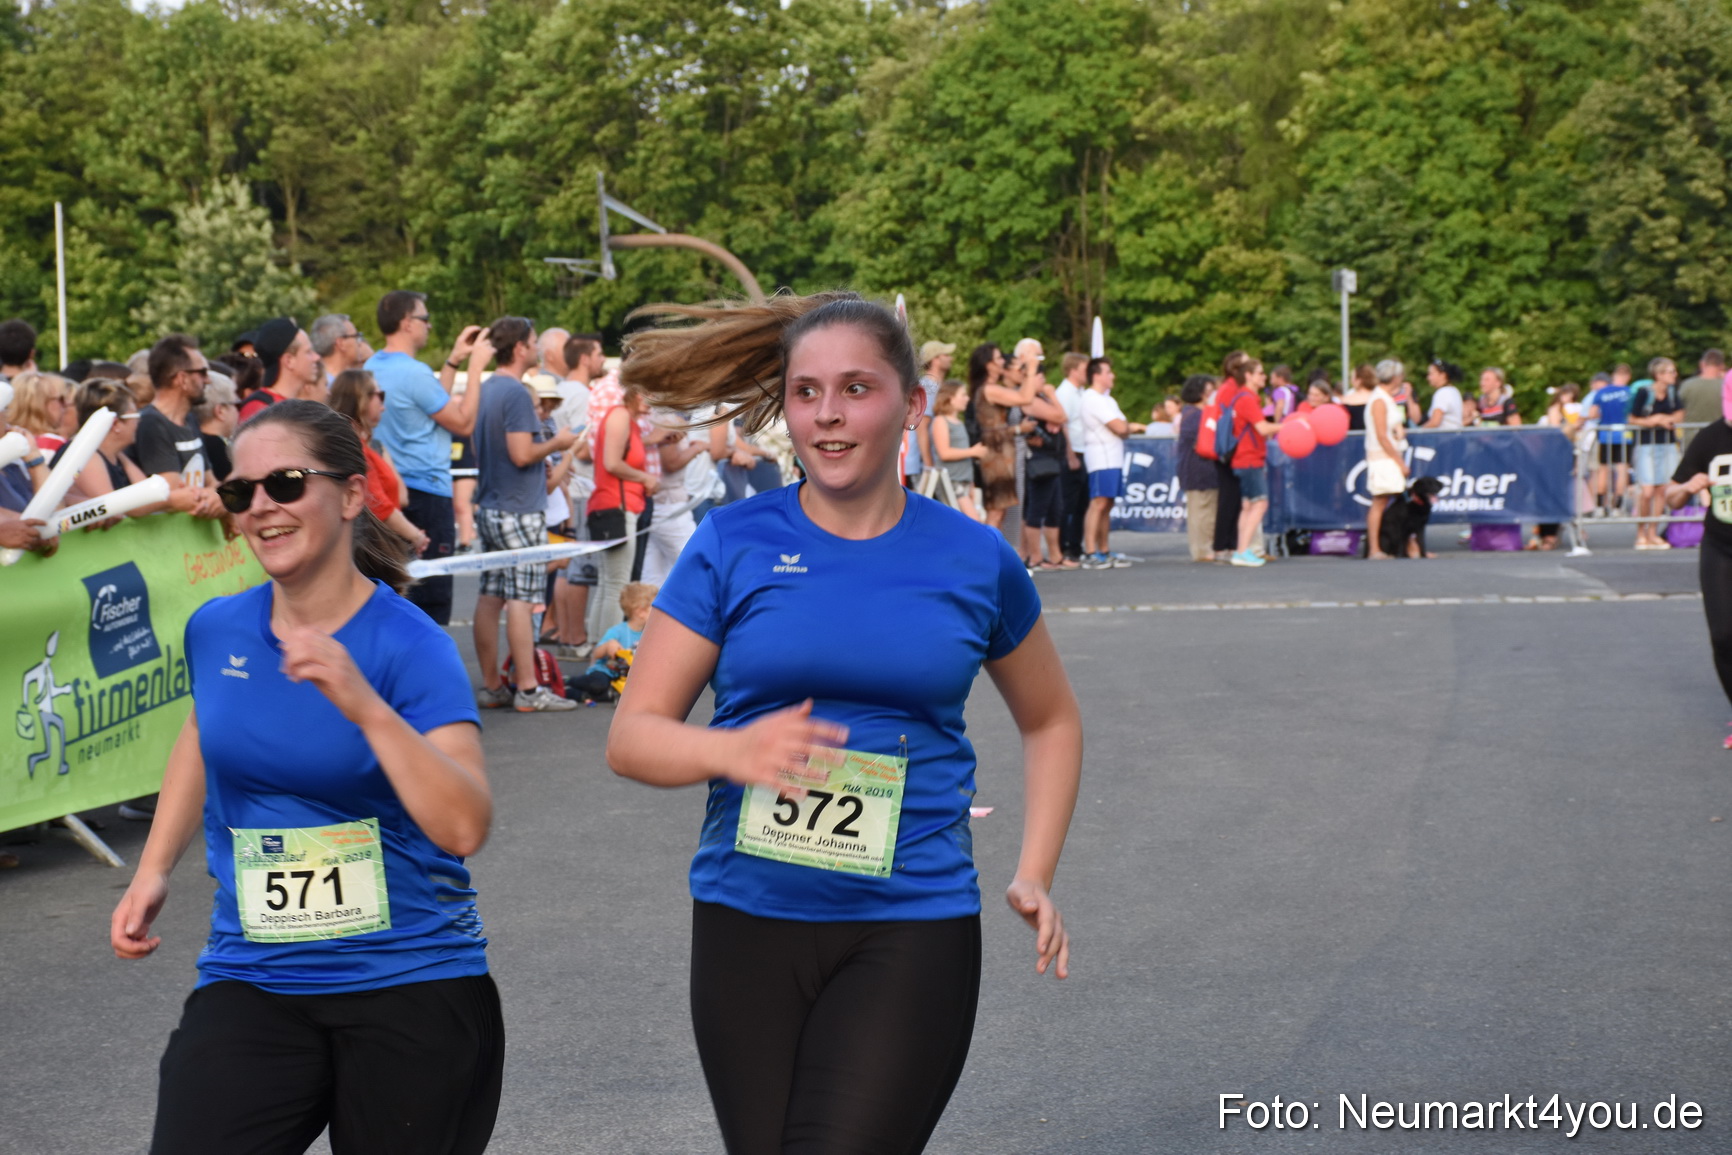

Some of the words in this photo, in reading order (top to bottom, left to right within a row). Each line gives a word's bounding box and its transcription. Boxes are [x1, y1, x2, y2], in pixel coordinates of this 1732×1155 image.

[1435, 468, 1518, 497] cher
[1109, 506, 1188, 519] AUTOMO
[1432, 497, 1505, 513] MOBILE
[101, 596, 141, 623] Fischer
[72, 644, 192, 741] firmenla
[77, 720, 141, 764] neumarkt
[865, 786, 893, 798] 2019
[773, 789, 864, 838] 572
[762, 825, 812, 845] Deppner
[815, 836, 867, 852] Johanna
[344, 850, 372, 864] 2019
[266, 866, 344, 911] 571
[260, 910, 311, 924] Deppisch
[315, 906, 362, 921] Barbara
